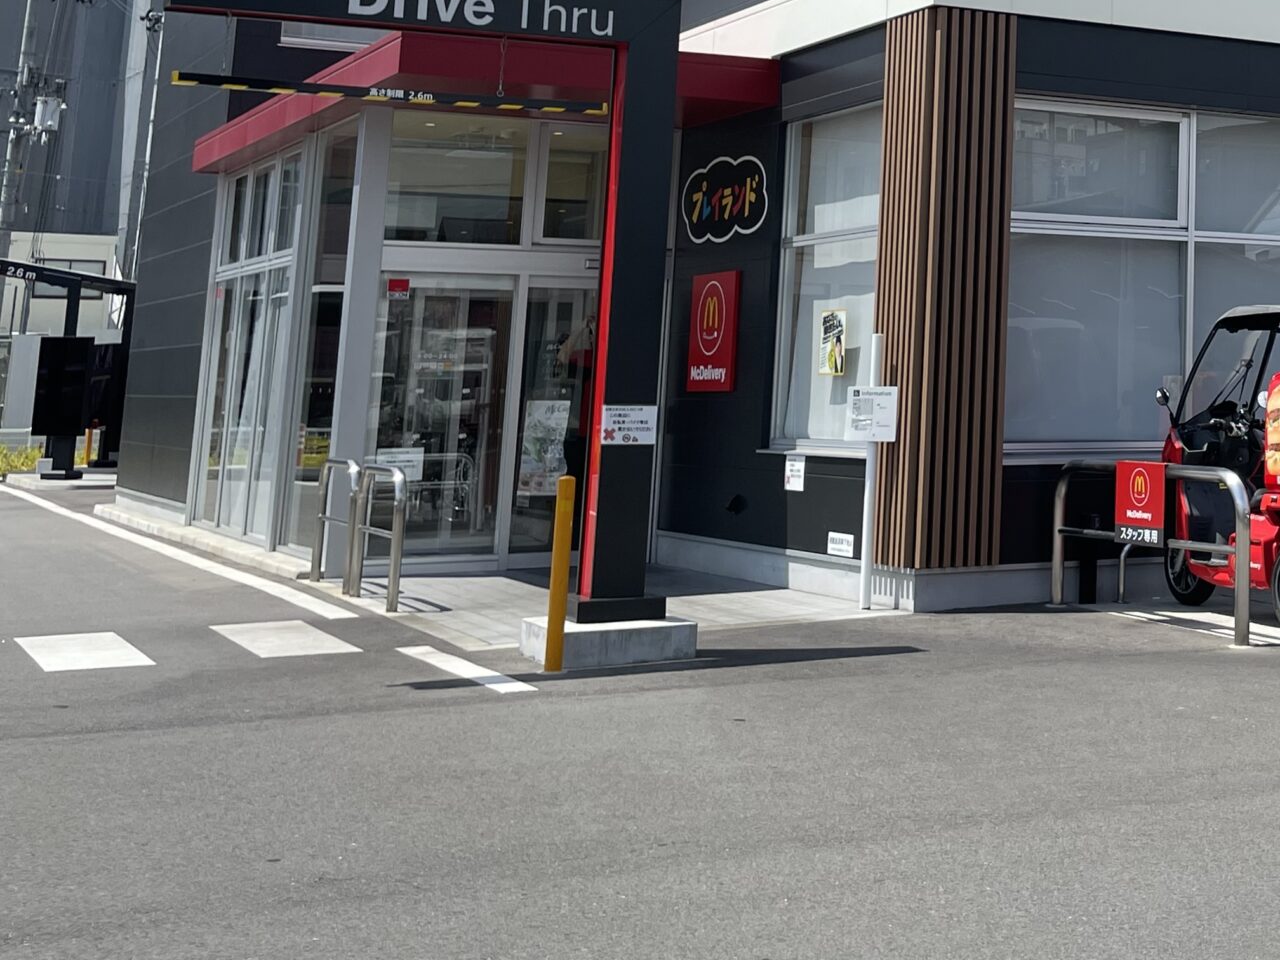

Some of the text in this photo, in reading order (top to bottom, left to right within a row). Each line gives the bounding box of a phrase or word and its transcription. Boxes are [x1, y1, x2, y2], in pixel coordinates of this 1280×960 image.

[692, 174, 759, 224] プレイランド
[690, 365, 726, 383] McDelivery
[1120, 527, 1158, 544] スタッフ専用
